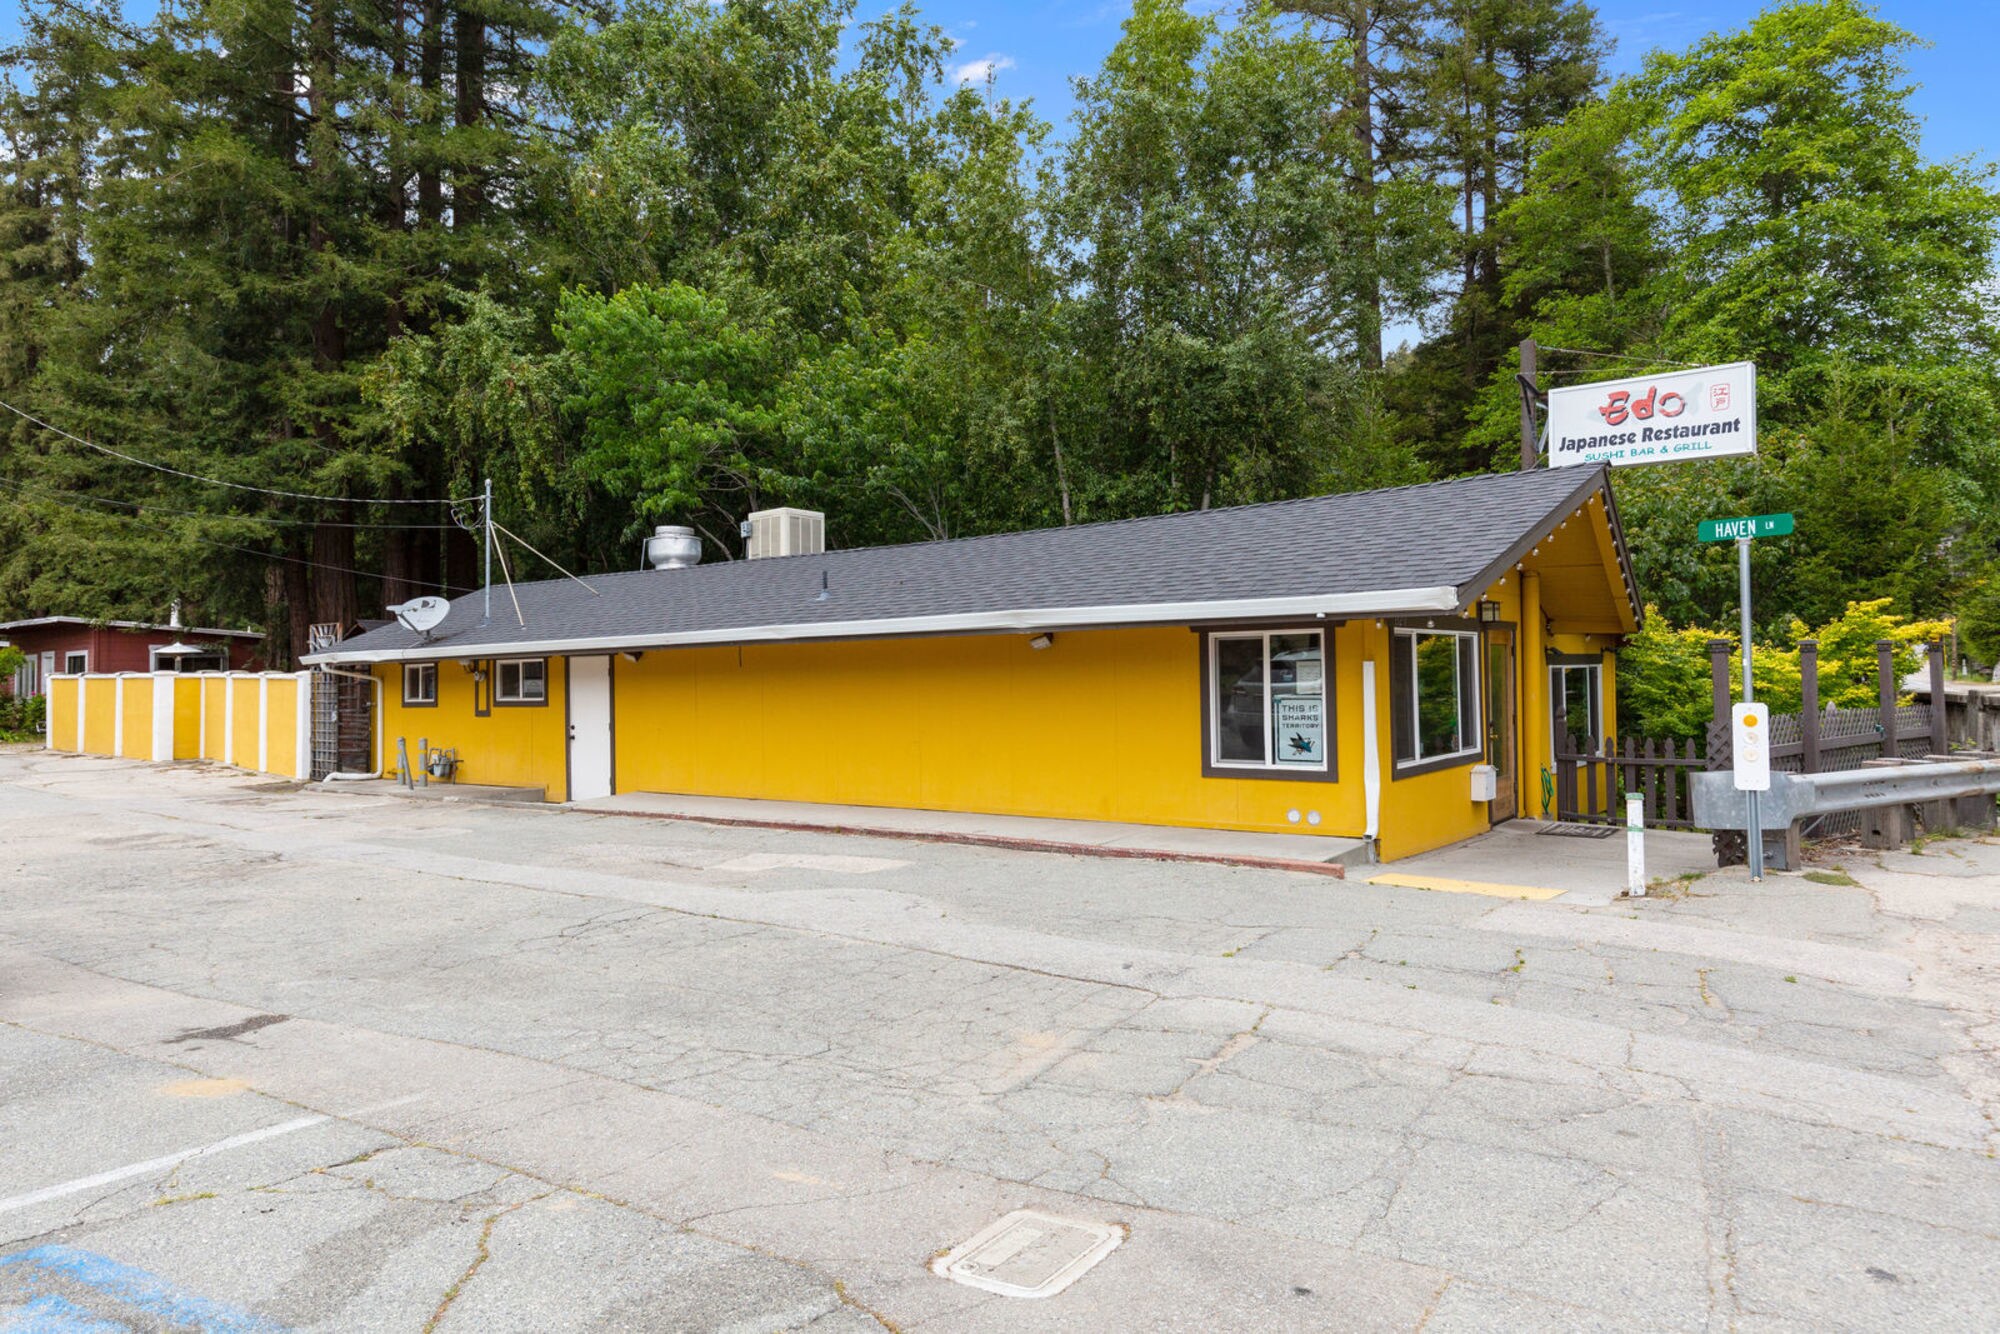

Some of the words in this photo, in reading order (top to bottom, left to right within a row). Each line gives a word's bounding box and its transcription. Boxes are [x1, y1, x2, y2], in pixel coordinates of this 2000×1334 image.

[1599, 385, 1687, 426] Edo
[1559, 431, 1636, 452] Japanese
[1641, 418, 1740, 442] Restaurant
[1584, 449, 1624, 462] SUSHI
[1630, 447, 1655, 458] BAR
[1660, 445, 1669, 454] &
[1673, 441, 1713, 453] GRILL
[1715, 520, 1756, 538] HAVEN
[1765, 521, 1774, 530] LN
[1282, 704, 1305, 712] THIS
[1309, 704, 1319, 712] IS
